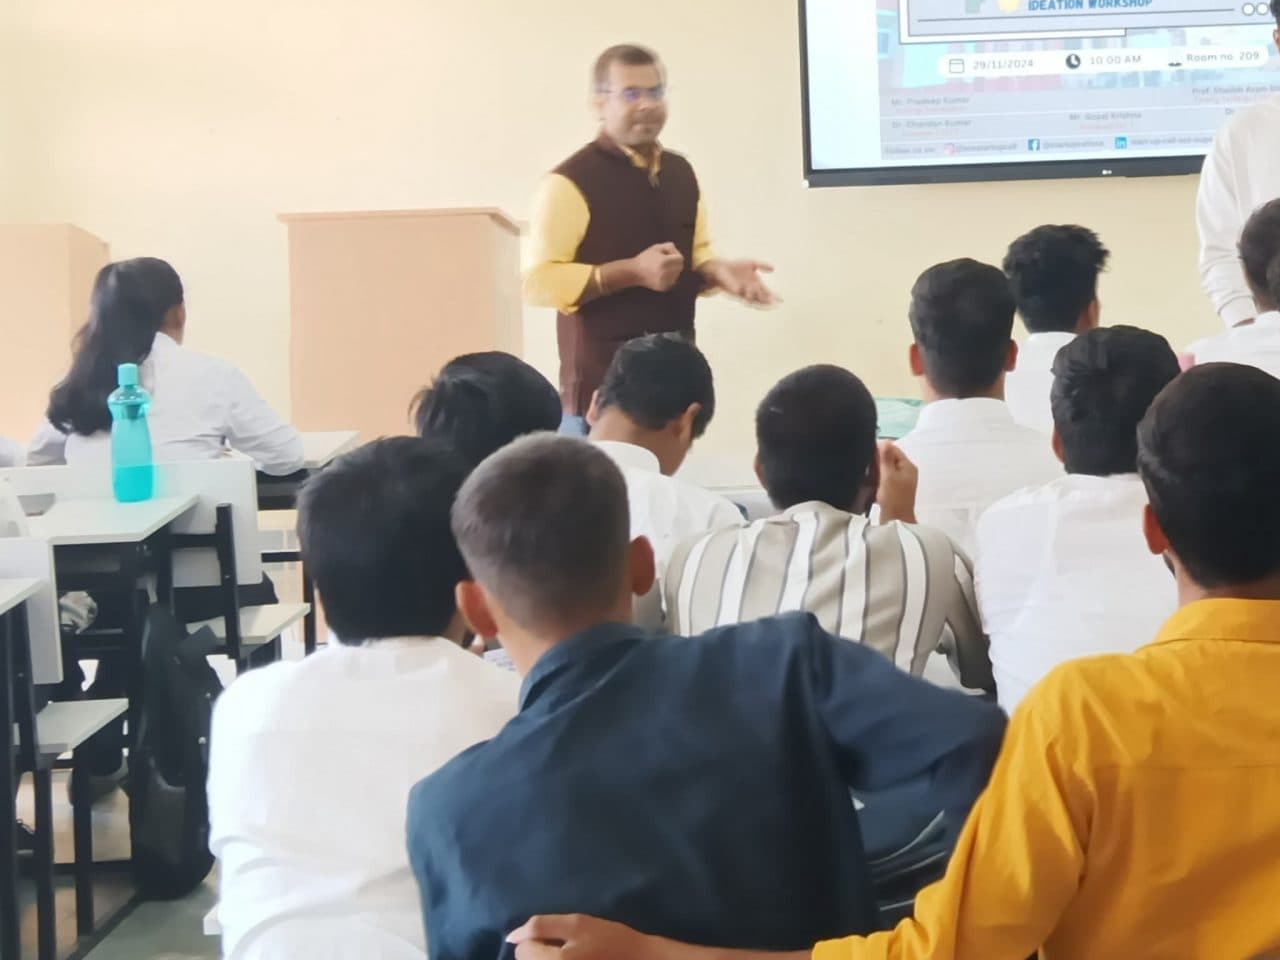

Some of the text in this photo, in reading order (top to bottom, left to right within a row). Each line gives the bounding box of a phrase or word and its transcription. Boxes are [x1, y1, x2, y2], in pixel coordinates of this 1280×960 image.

[1028, 0, 1084, 11] IDEATION
[1124, 55, 1142, 64] AM
[1186, 52, 1217, 63] Room
[1239, 50, 1260, 61] 209
